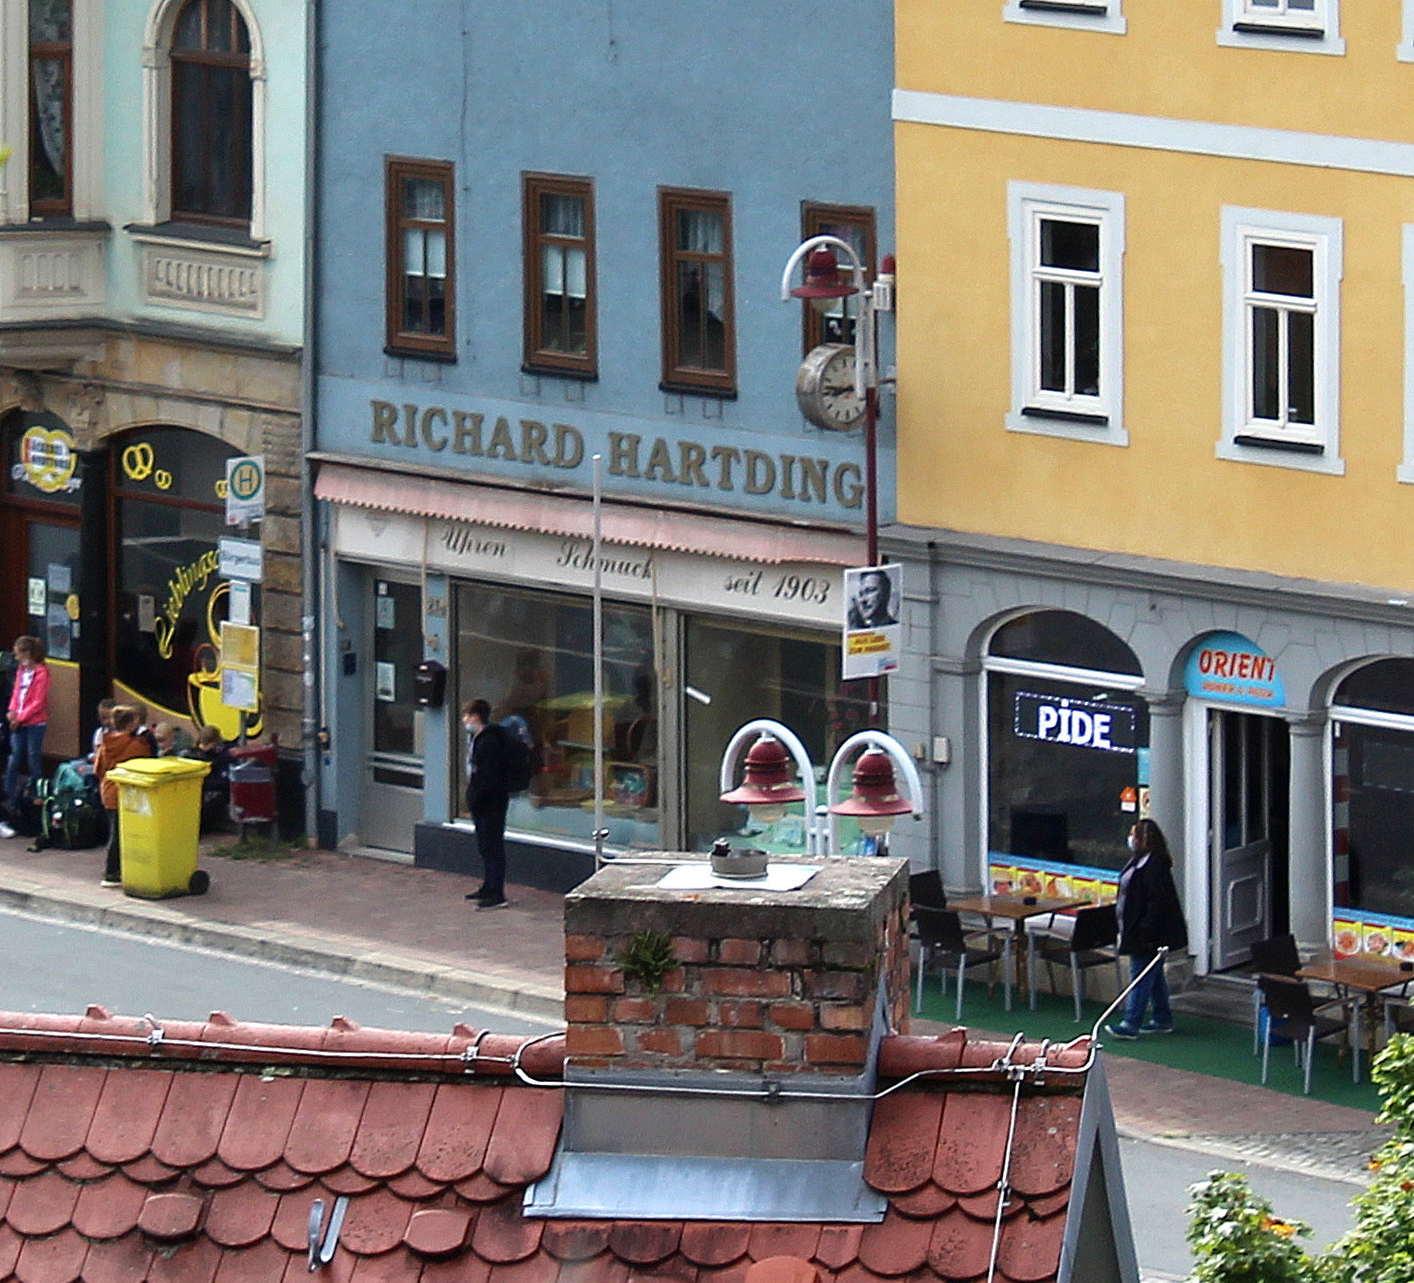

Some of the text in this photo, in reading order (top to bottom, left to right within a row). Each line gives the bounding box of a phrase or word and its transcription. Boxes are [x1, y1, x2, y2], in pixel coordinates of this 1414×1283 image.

[370, 399, 866, 510] RICHARD HARTDING
[441, 524, 832, 605] Uhren Schmuck seit 1903
[1199, 648, 1276, 683] ORIENT
